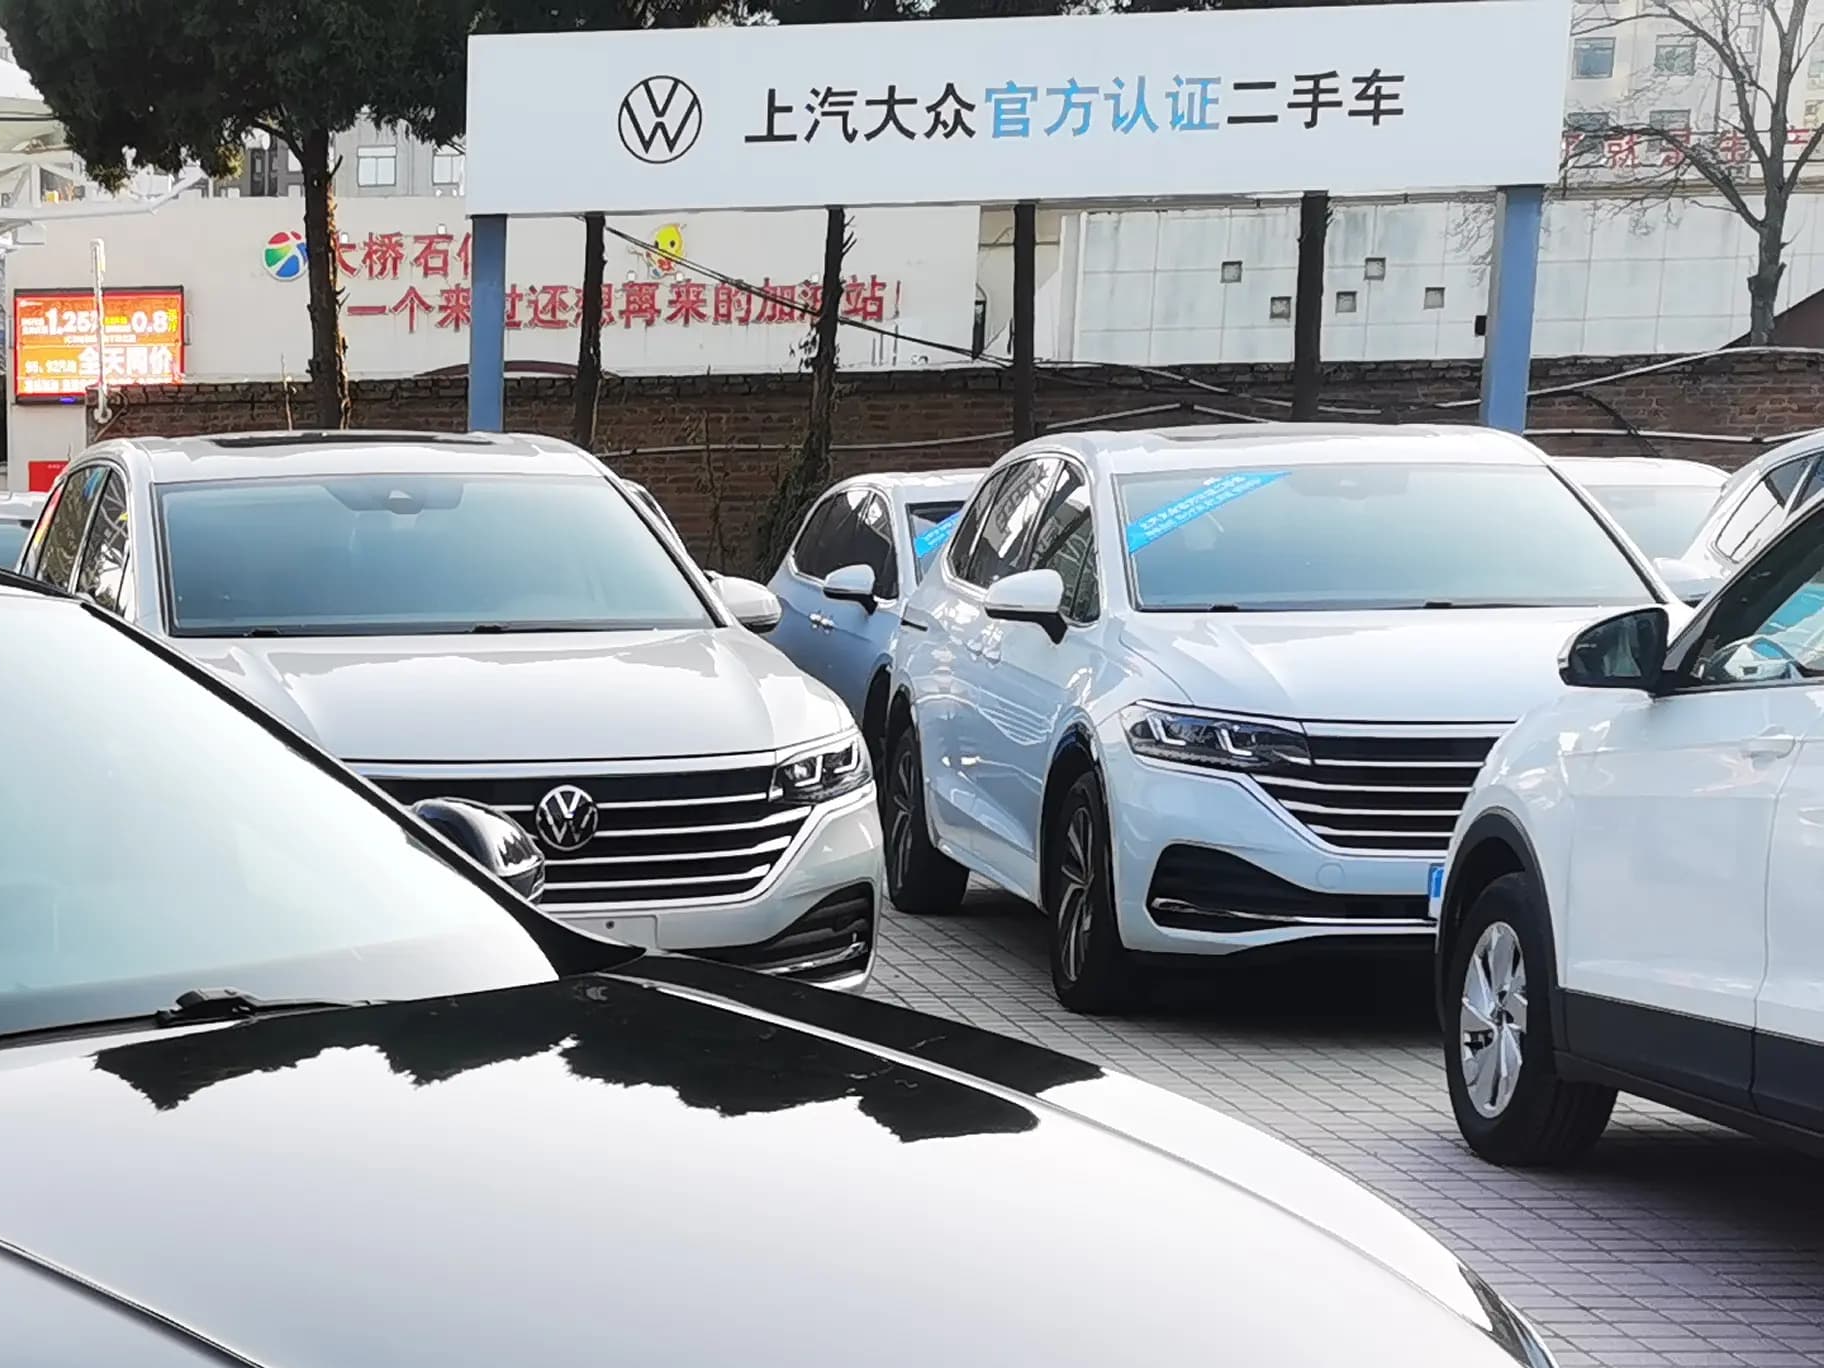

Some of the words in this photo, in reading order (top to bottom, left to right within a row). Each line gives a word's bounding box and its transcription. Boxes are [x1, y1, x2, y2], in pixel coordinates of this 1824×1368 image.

[744, 69, 1406, 144] 上汽大众官方认证二手车
